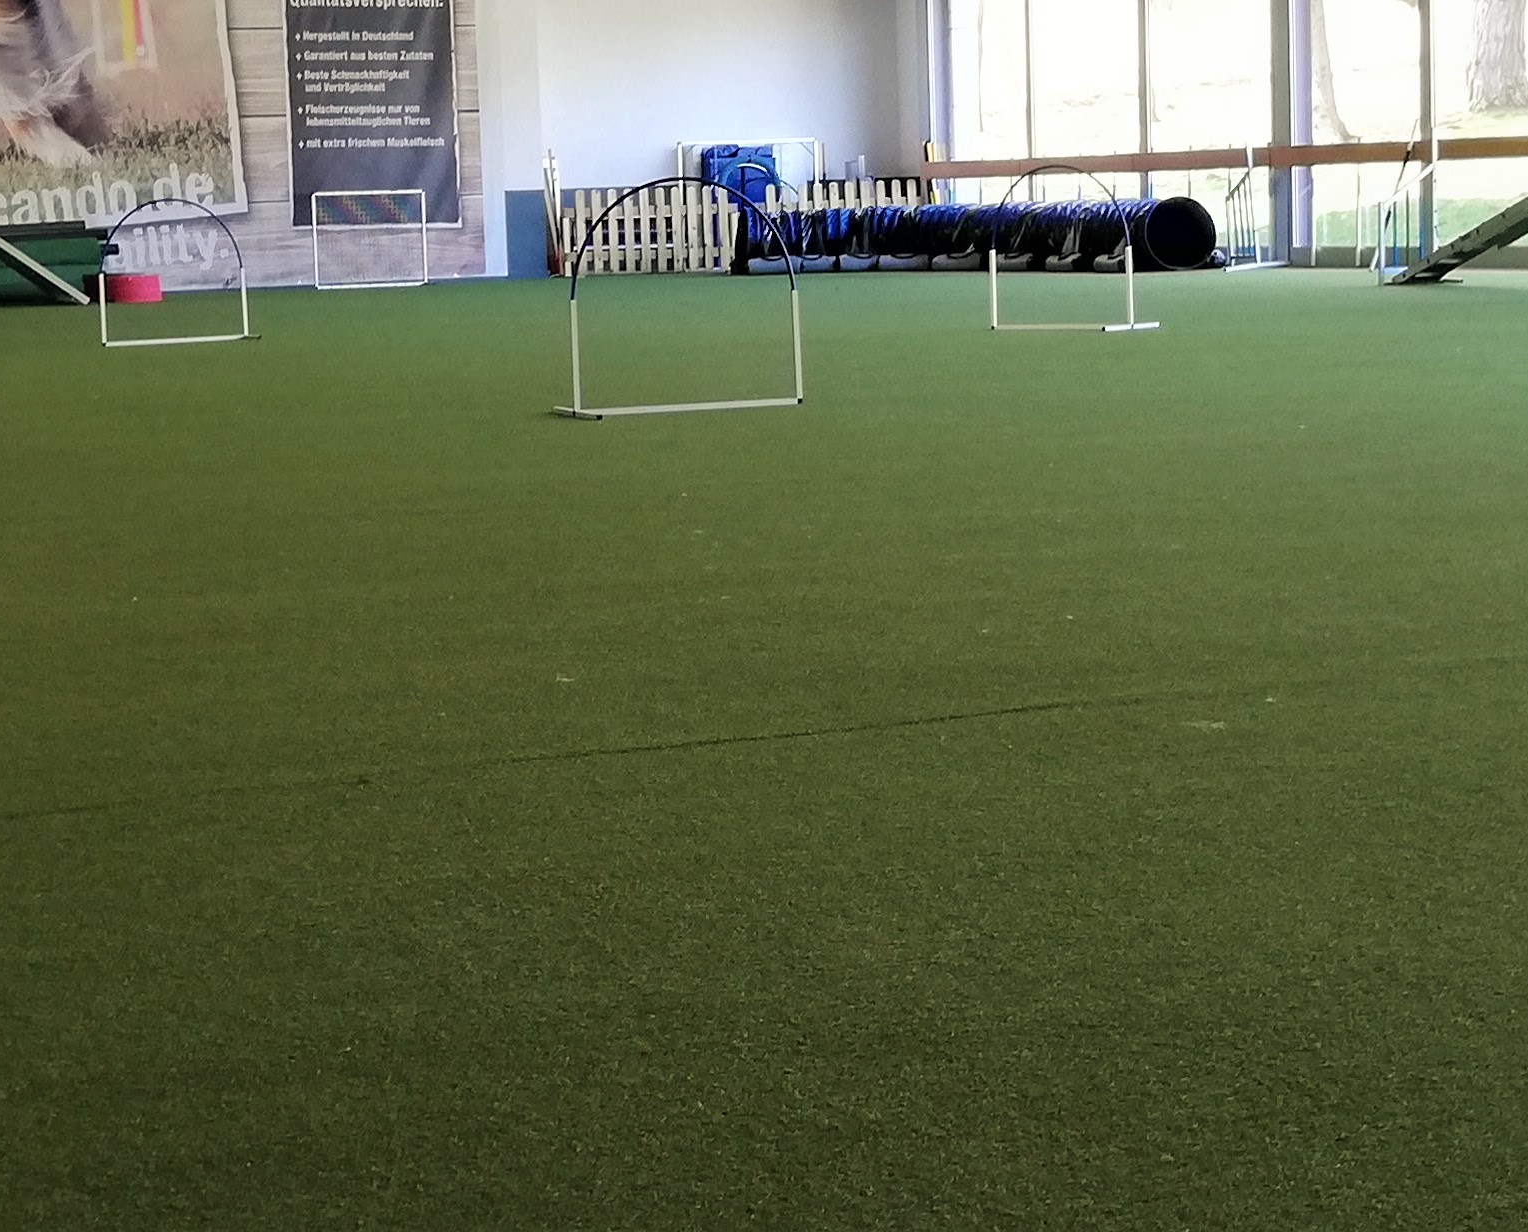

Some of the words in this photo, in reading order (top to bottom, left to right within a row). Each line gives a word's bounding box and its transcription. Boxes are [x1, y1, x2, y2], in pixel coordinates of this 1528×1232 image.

[302, 31, 350, 43] Hergestellt
[351, 31, 360, 41] in
[362, 31, 414, 41] Deutschland
[303, 50, 348, 61] Garantiert
[350, 52, 366, 61] aus
[368, 49, 398, 61] besten
[399, 50, 434, 61] Zutaten
[303, 69, 329, 80] Beste
[331, 69, 410, 81] Schmackhaftigkeit
[305, 82, 322, 92] und
[387, 105, 403, 114] nur
[404, 105, 420, 114] von
[306, 138, 321, 148] mit
[323, 138, 346, 148] extra
[387, 137, 445, 148] Muskelfleisch
